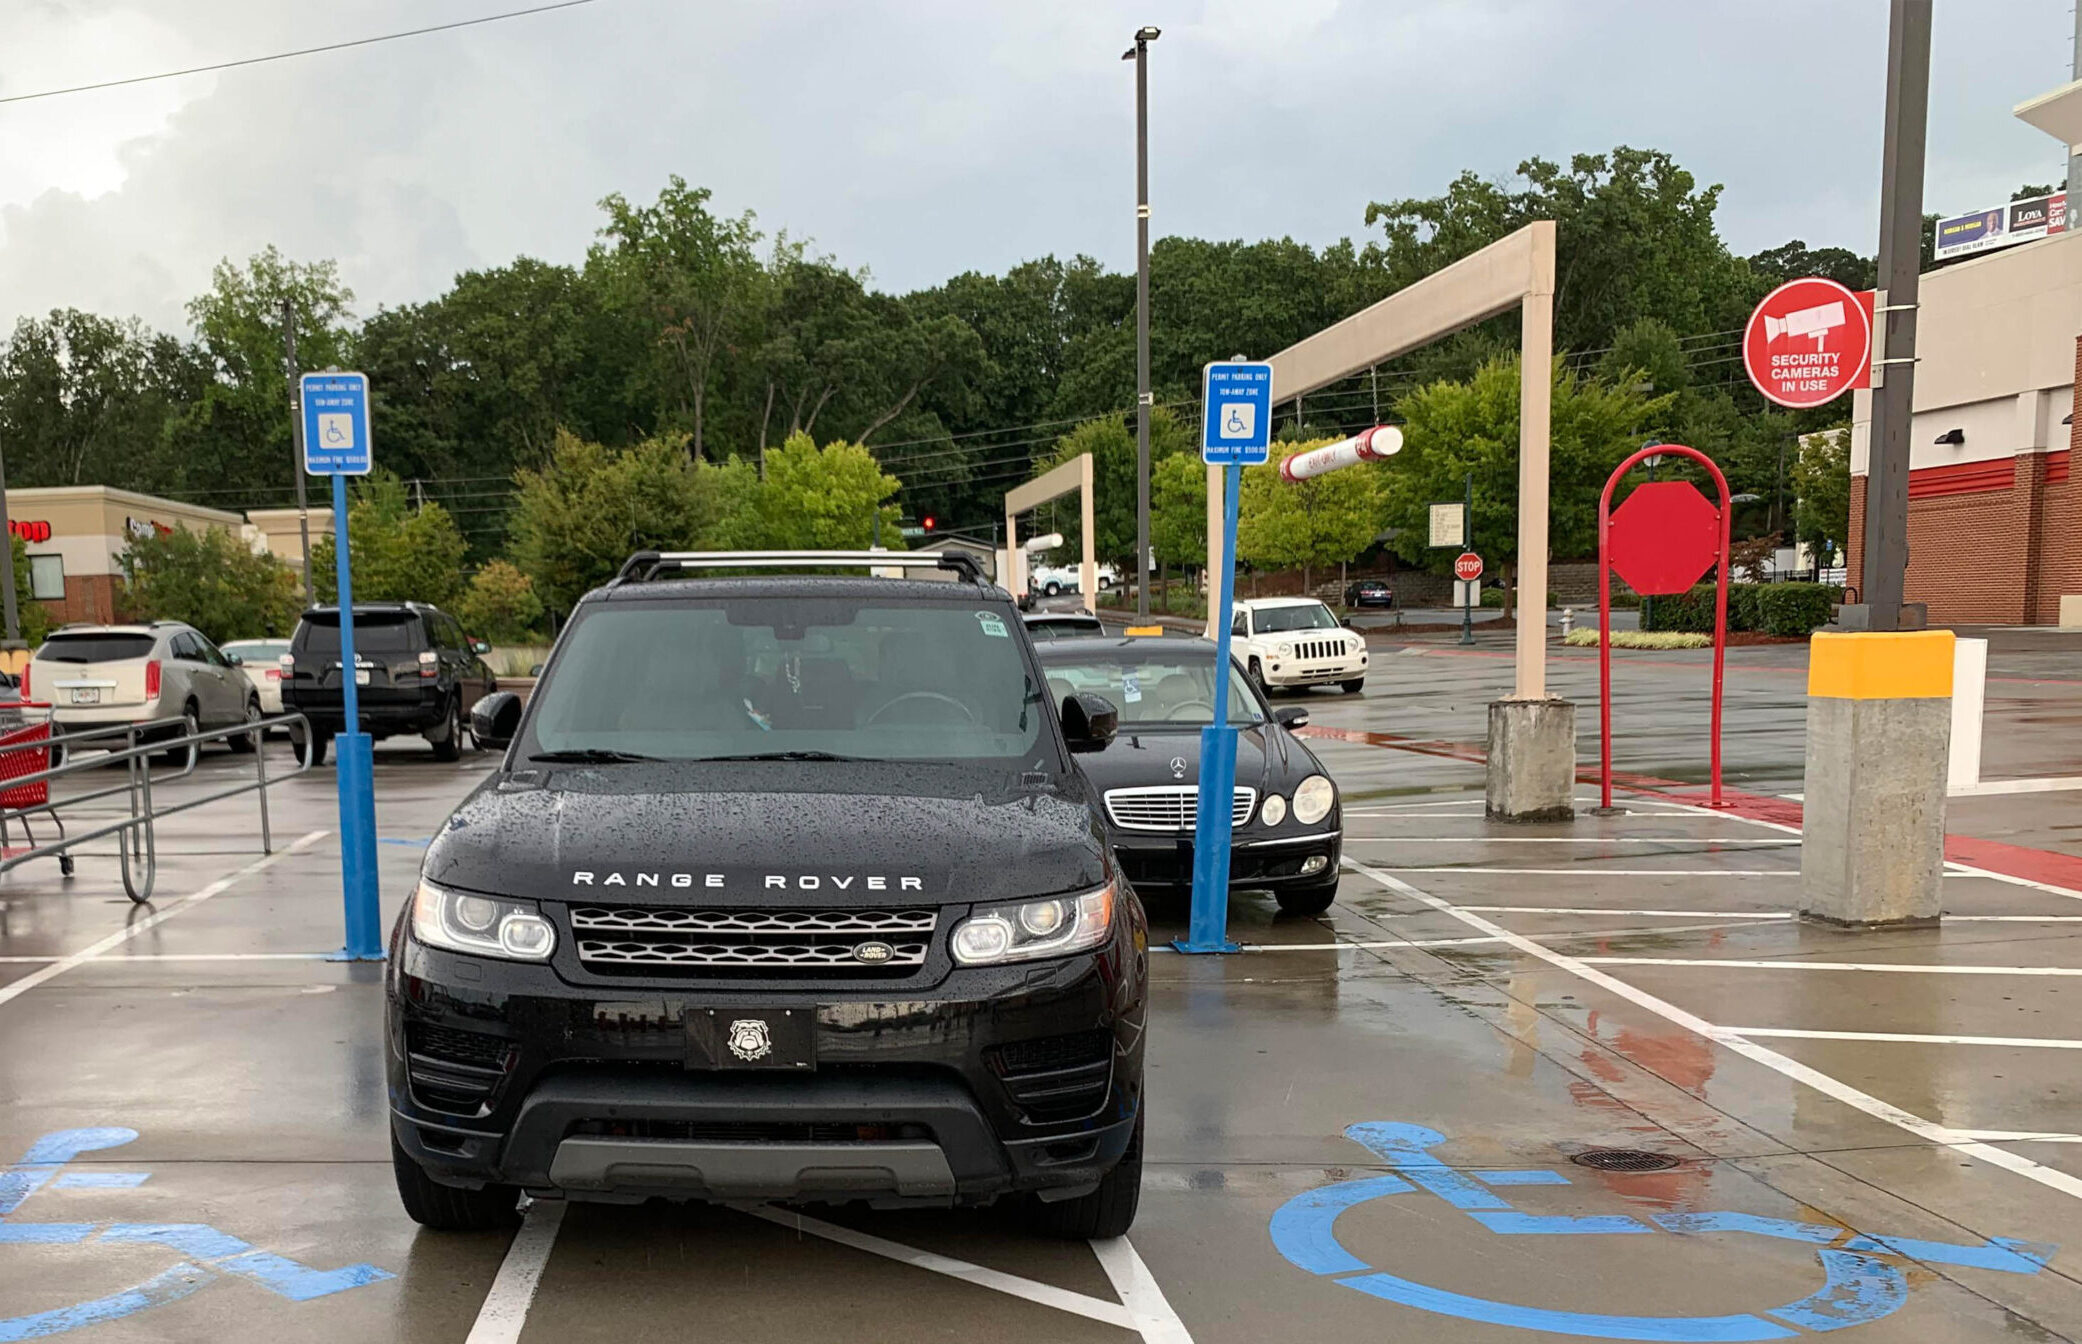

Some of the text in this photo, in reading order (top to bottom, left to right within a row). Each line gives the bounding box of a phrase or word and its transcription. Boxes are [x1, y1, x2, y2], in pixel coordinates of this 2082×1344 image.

[2018, 209, 2042, 222] LOYA
[1771, 352, 1841, 366] SECURITY
[1211, 373, 1268, 381] PERMIT PARKING ONLY
[1771, 366, 1839, 380] CAMERAS
[1245, 388, 1259, 396] ZONE
[1782, 379, 1828, 392] IN USE
[1206, 446, 1230, 454] MAXIMUM
[1230, 446, 1242, 454] FINE
[1457, 561, 1480, 572] STOP
[572, 871, 923, 890] RANGE ROVER
